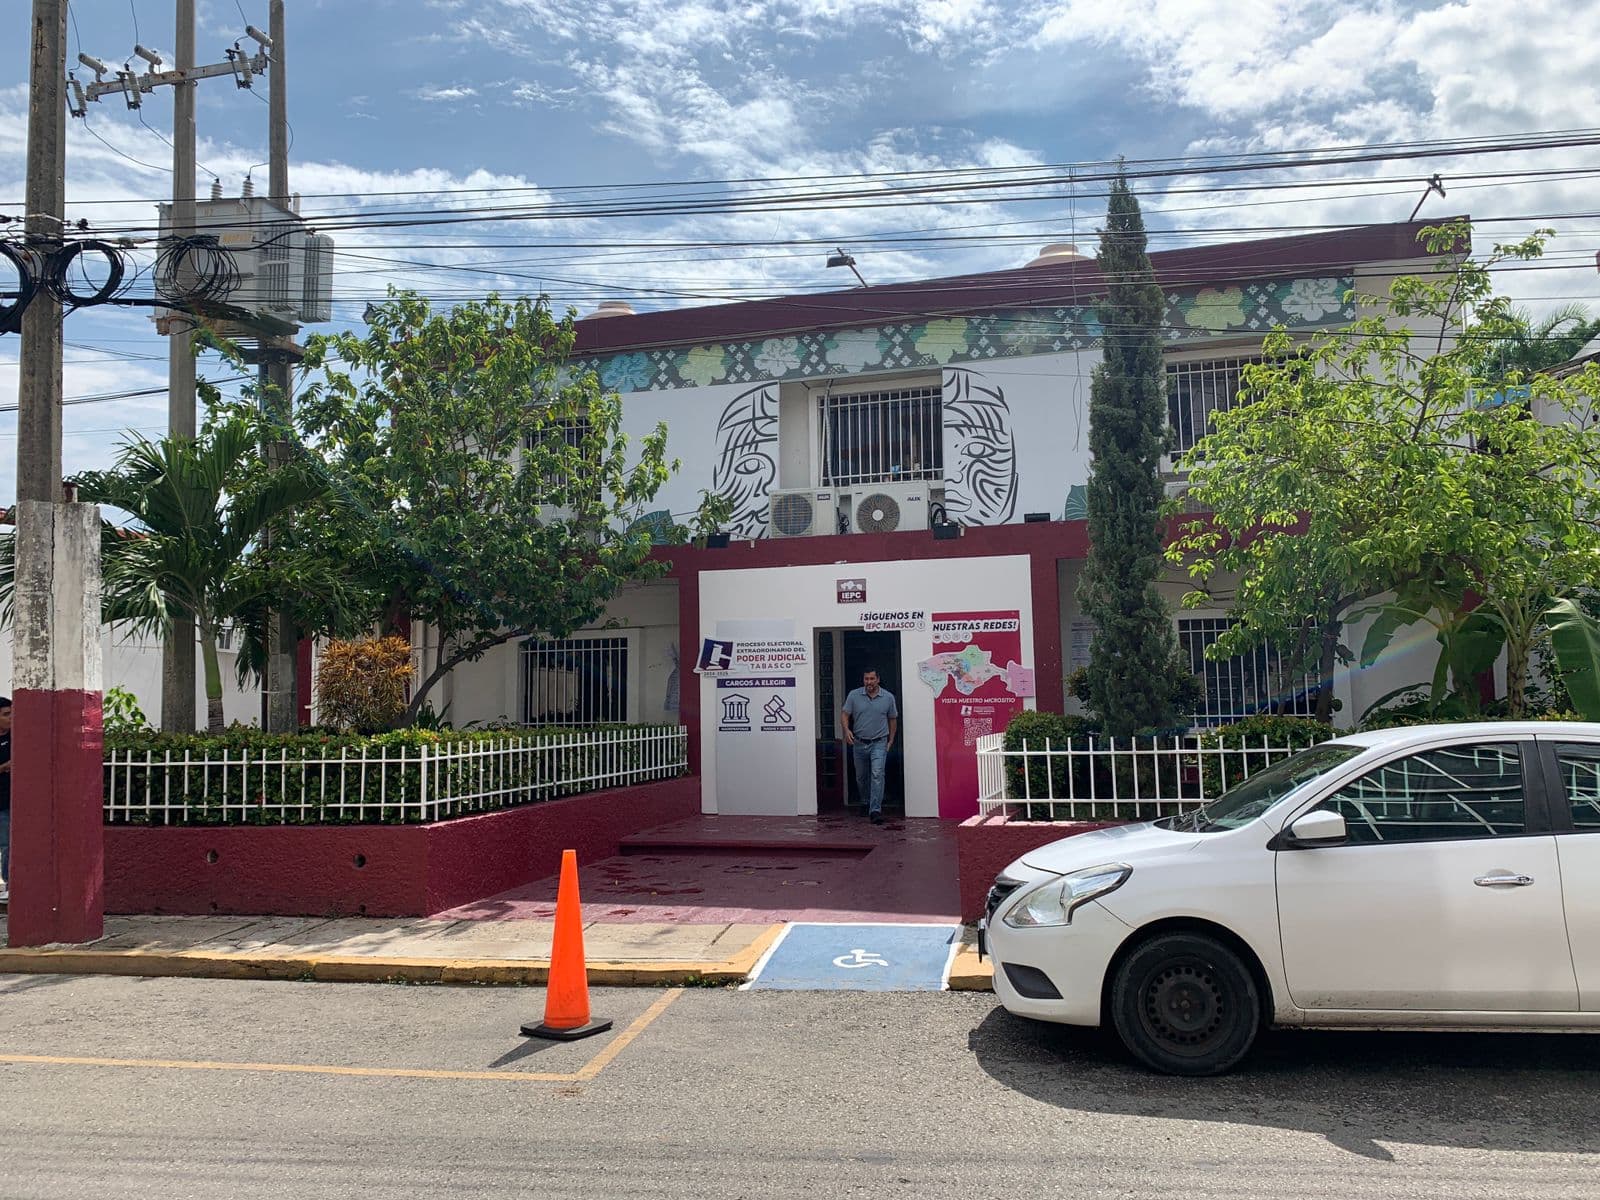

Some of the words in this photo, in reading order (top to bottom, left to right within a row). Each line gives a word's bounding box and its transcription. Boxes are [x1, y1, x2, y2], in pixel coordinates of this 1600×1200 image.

[911, 611, 924, 619] EN
[933, 622, 980, 631] NUESTRAS
[983, 621, 1017, 629] REDES!
